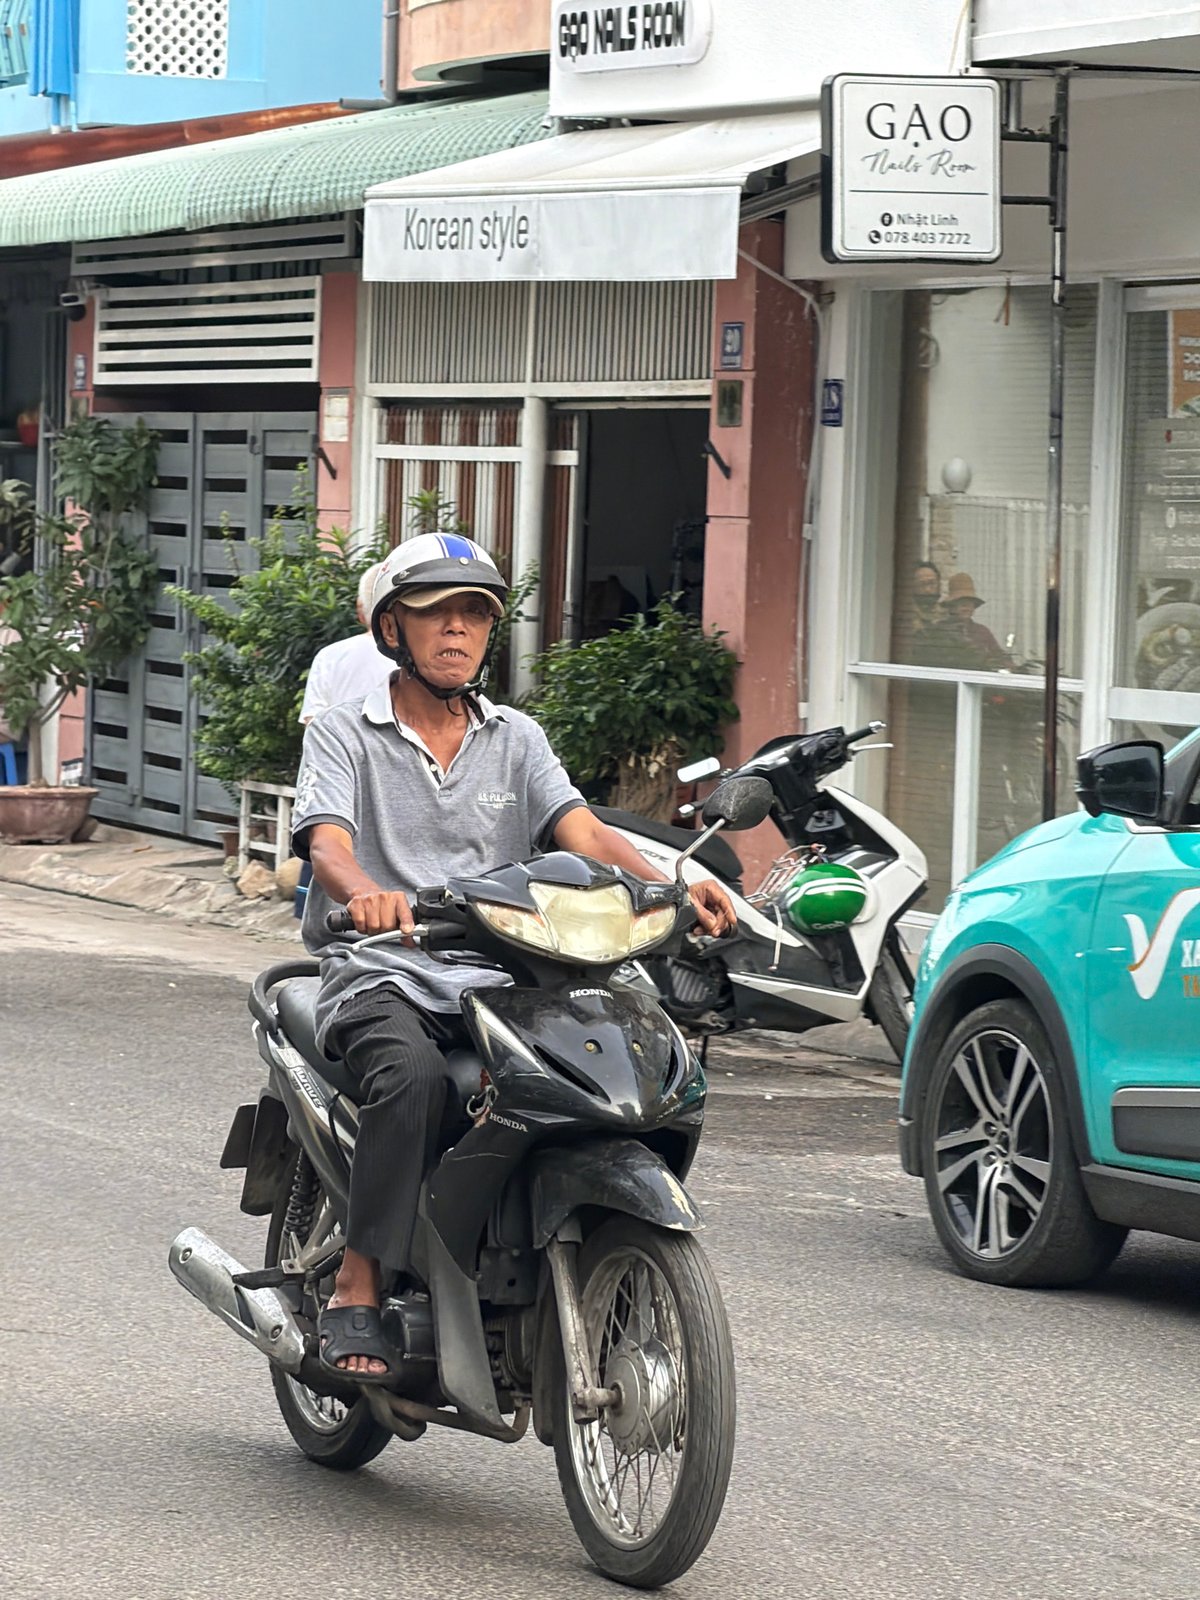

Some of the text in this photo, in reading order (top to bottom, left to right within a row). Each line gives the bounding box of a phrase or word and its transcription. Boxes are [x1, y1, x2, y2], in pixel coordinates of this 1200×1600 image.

[594, 6, 638, 54] NAILS
[642, 0, 686, 50] ROOM
[861, 148, 977, 178] Nails Room
[931, 214, 959, 226] Linh
[404, 205, 530, 262] Korean style
[884, 231, 971, 245] 078 403 7272
[569, 988, 614, 1000] HONDA
[489, 1112, 528, 1132] HONDA
